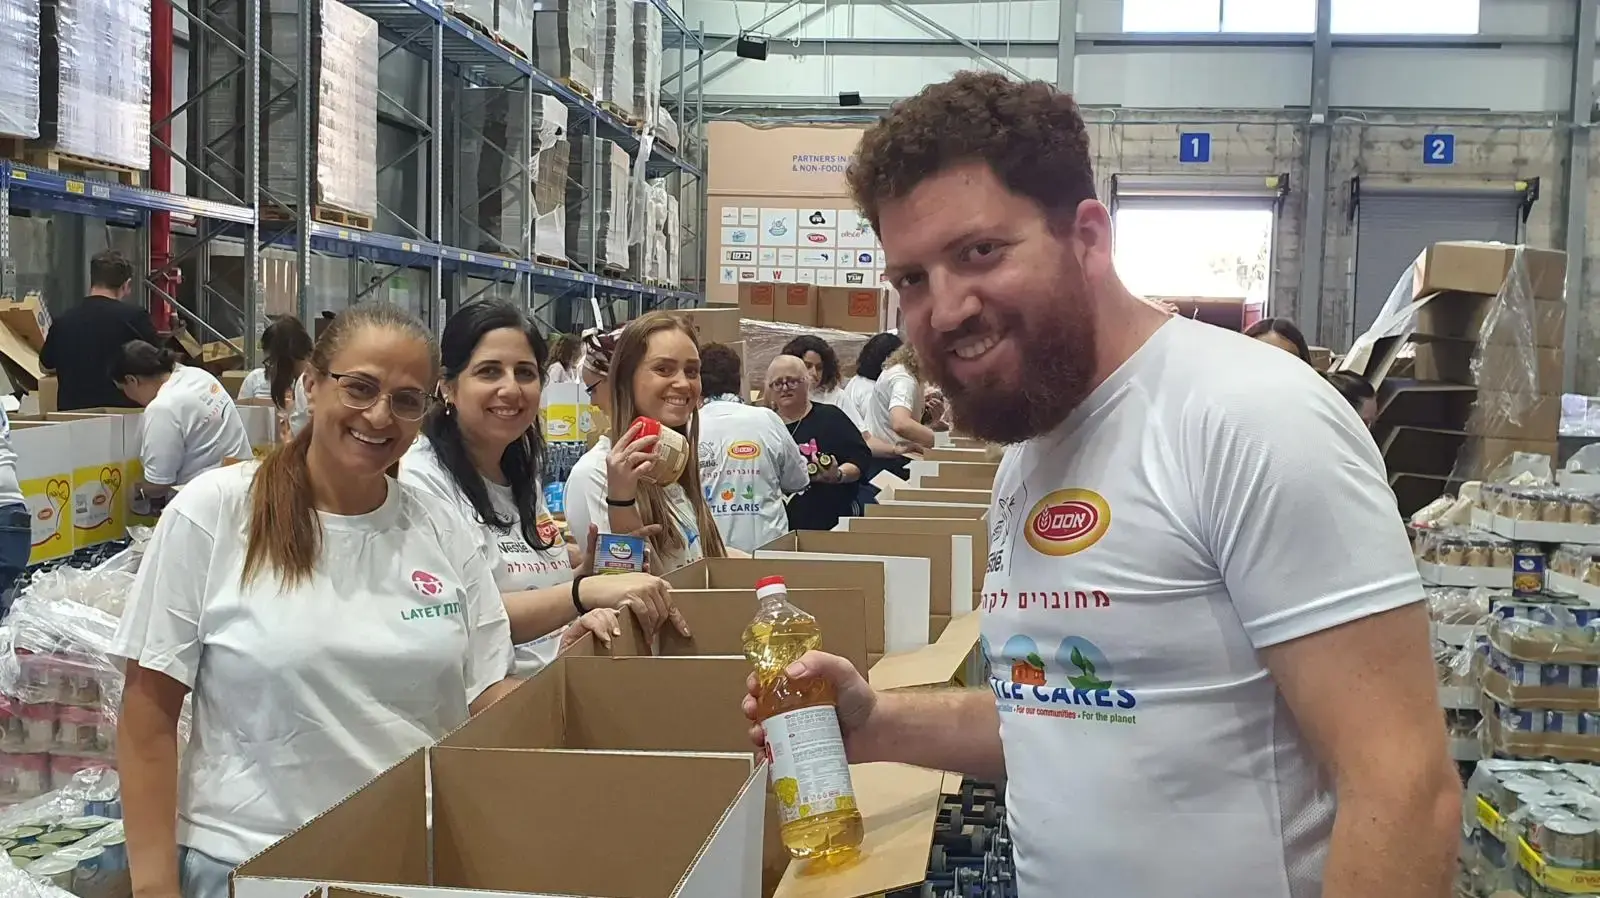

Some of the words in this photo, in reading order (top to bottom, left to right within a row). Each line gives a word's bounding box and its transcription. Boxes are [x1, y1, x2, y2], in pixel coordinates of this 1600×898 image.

[1190, 138, 1200, 158] 1
[1431, 139, 1446, 160] 2
[711, 502, 728, 513] TLÉ
[550, 559, 571, 570] רים
[1018, 590, 1111, 609] מחוברים
[401, 605, 442, 620] LATET
[1037, 707, 1077, 719] communities
[1082, 711, 1094, 720] For
[1096, 712, 1109, 722] the
[1110, 713, 1137, 724] planet
